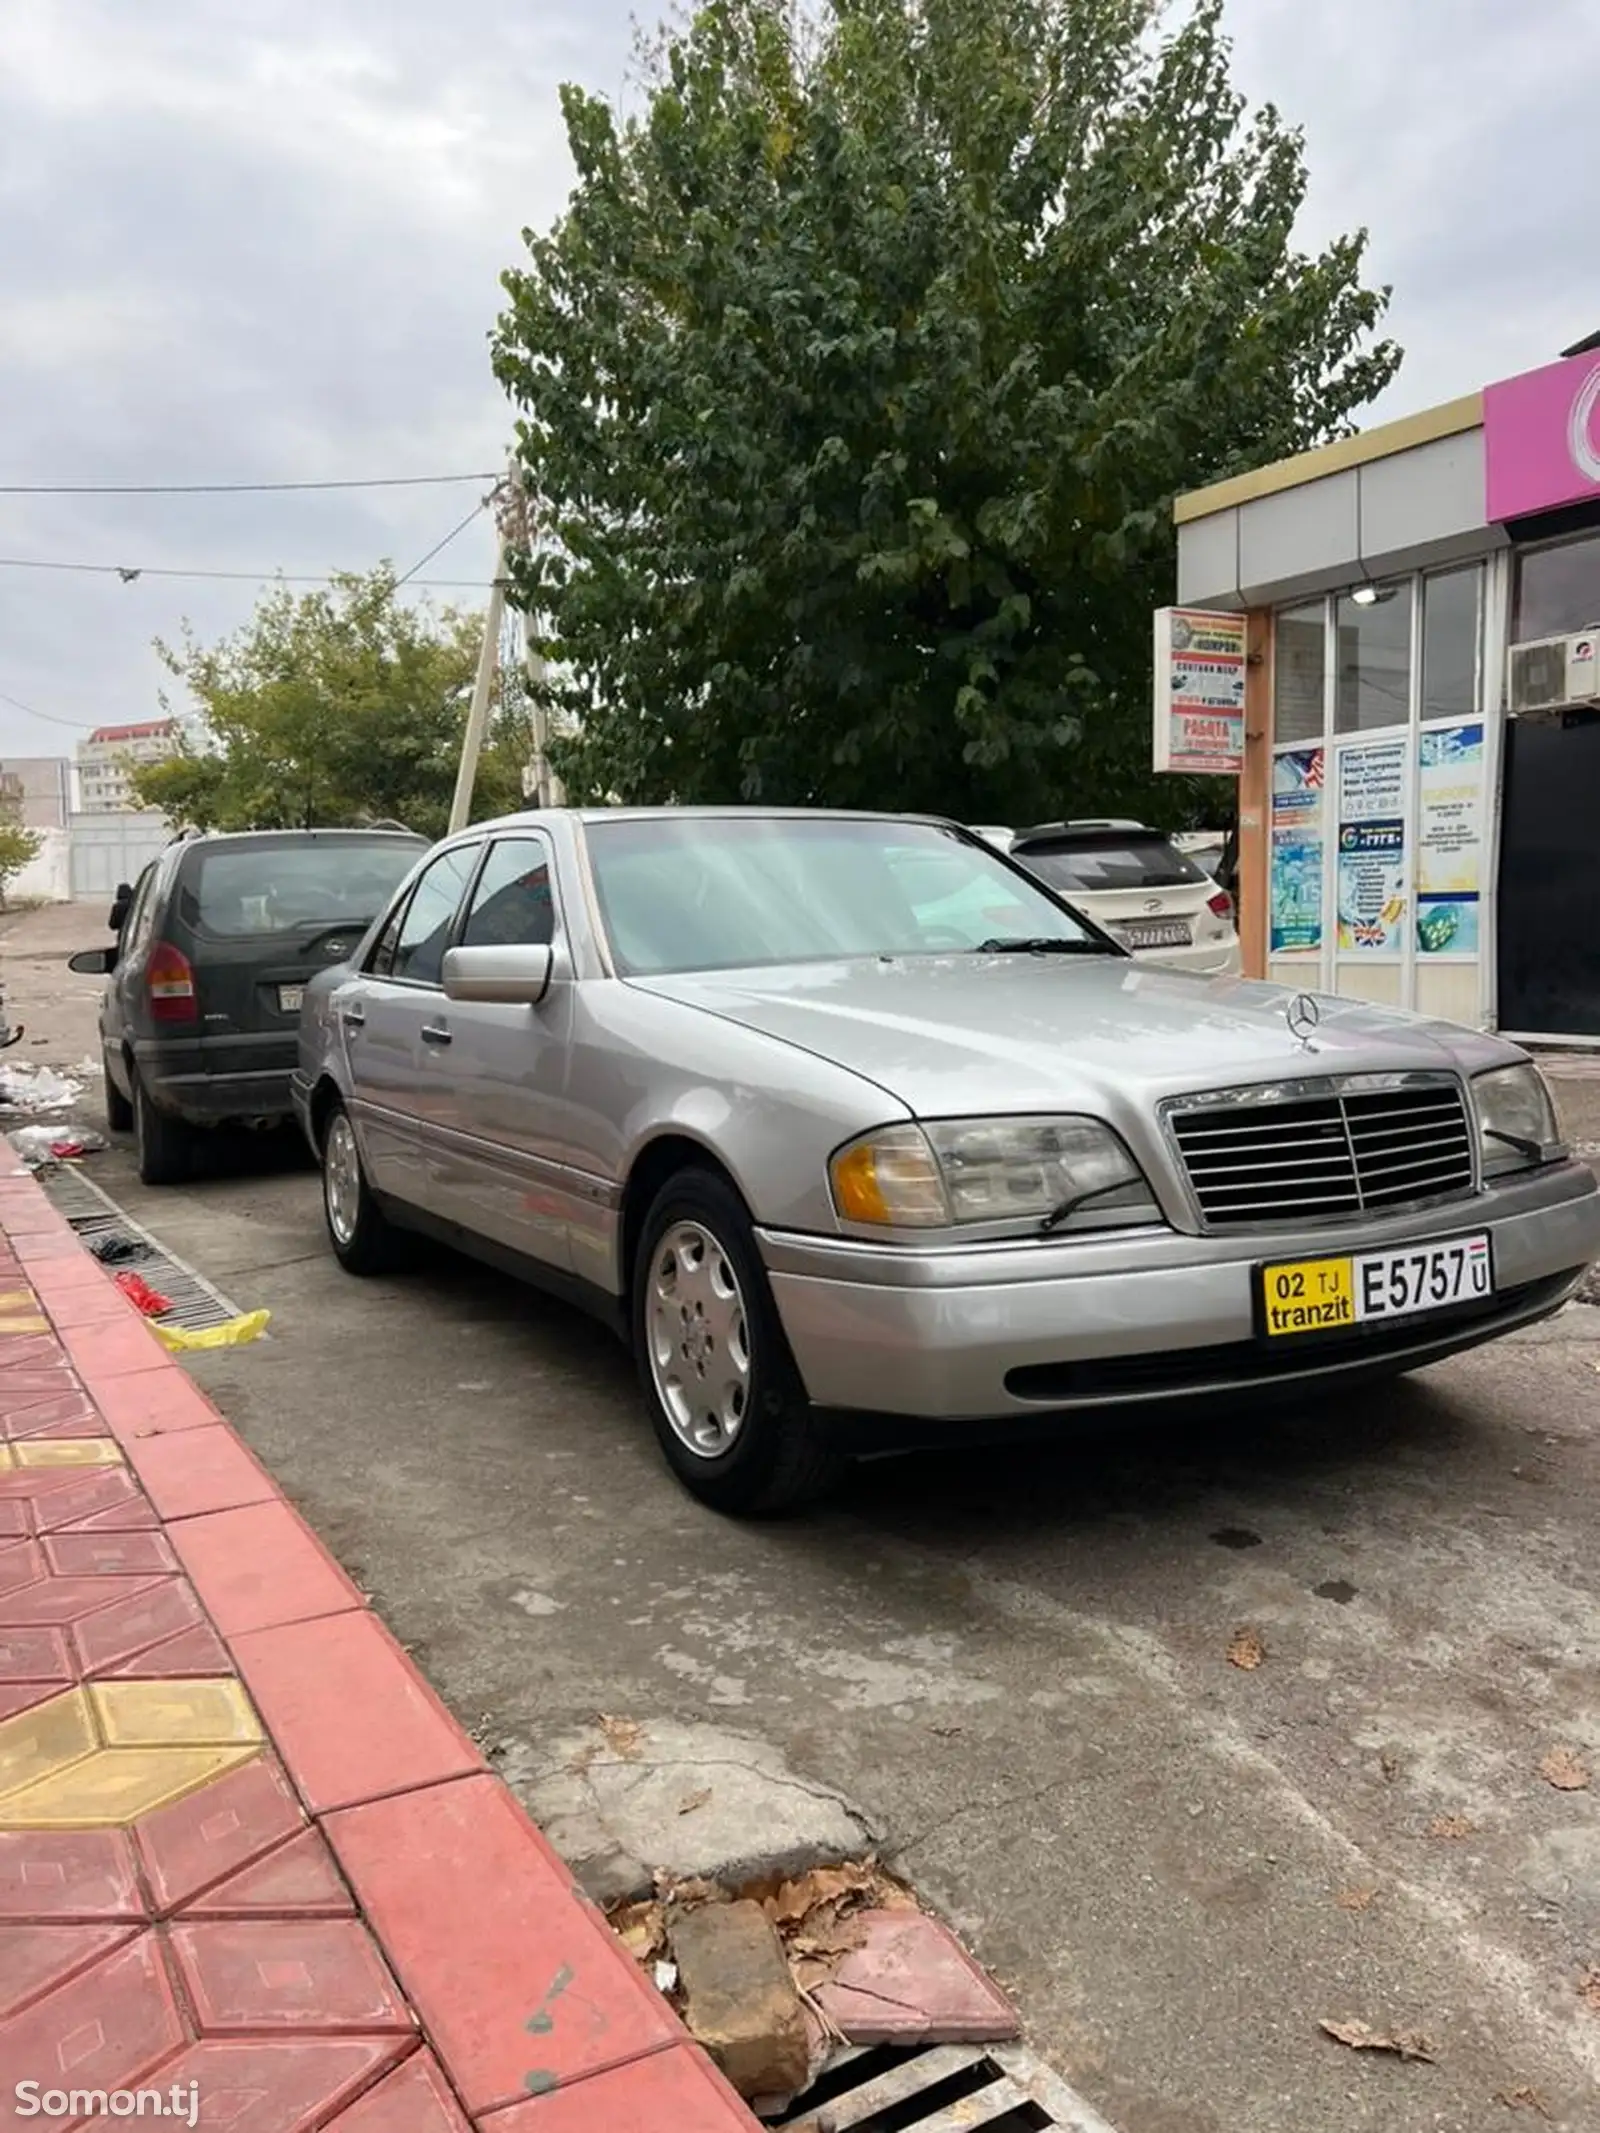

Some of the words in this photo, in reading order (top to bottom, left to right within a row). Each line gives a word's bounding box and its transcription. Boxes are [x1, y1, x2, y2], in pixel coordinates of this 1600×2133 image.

[1184, 718, 1229, 737] РАБОТА
[1276, 1272, 1305, 1299] 02
[1318, 1273, 1340, 1295] TJ
[1362, 1248, 1465, 1314] E5757
[1271, 1295, 1350, 1329] tranzit
